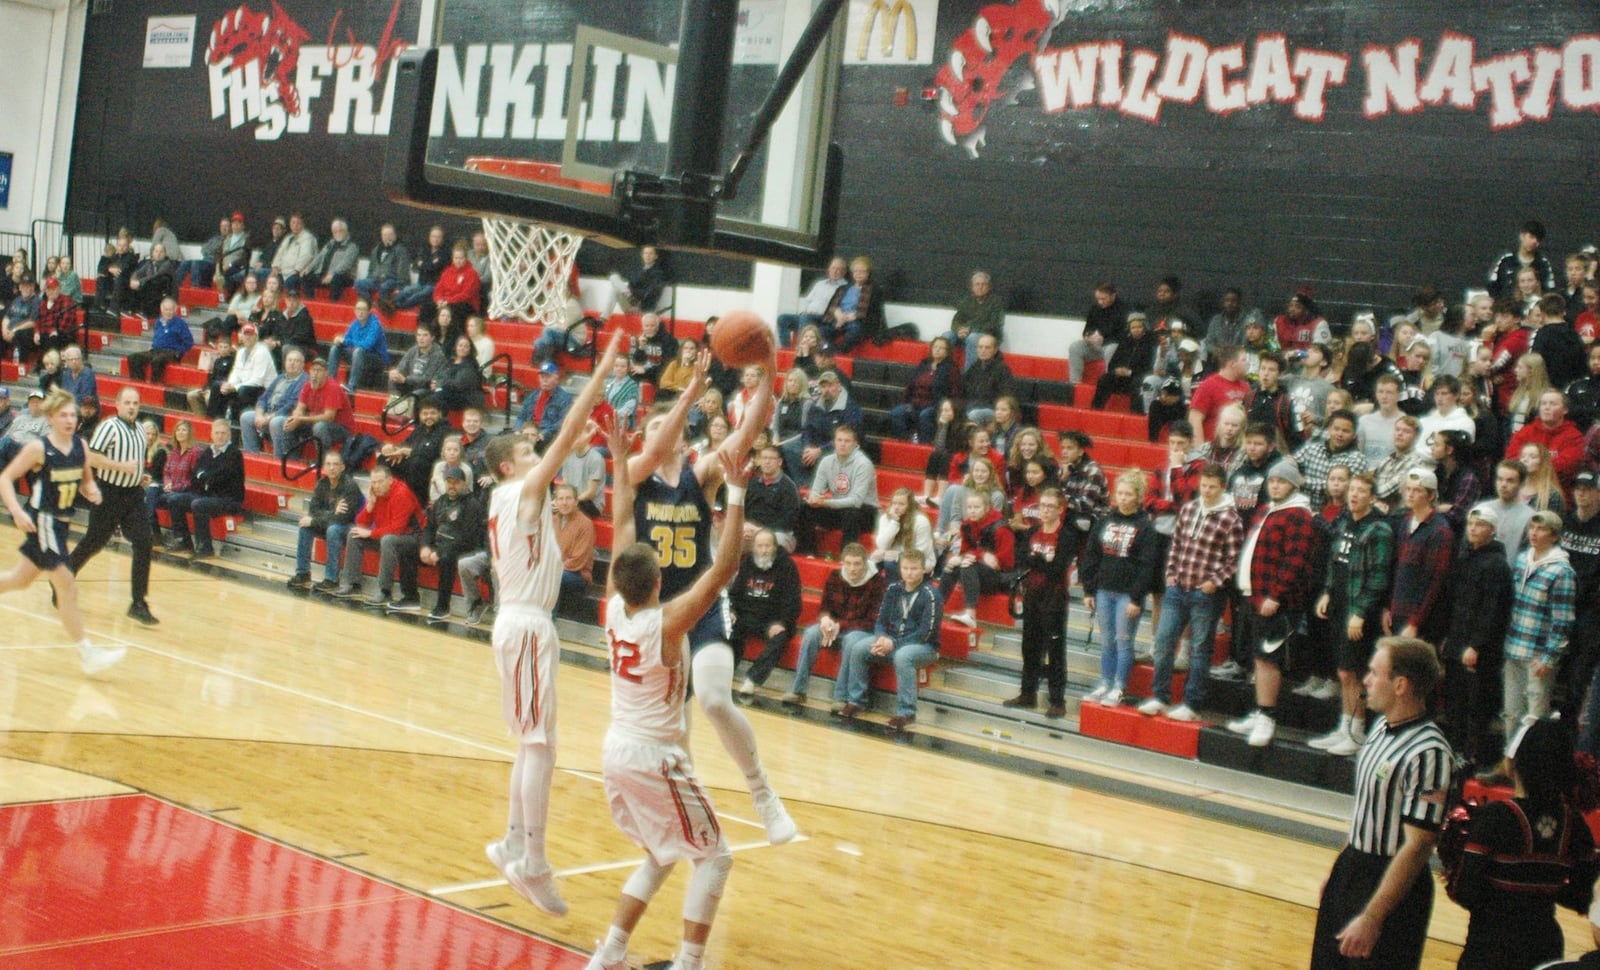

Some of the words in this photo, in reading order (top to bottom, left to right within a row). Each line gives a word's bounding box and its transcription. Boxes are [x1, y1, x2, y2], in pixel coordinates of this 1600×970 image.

[208, 57, 287, 140] FHS
[1032, 30, 1349, 123] WILDCAT
[651, 525, 697, 568] 35
[608, 628, 644, 685] 12
